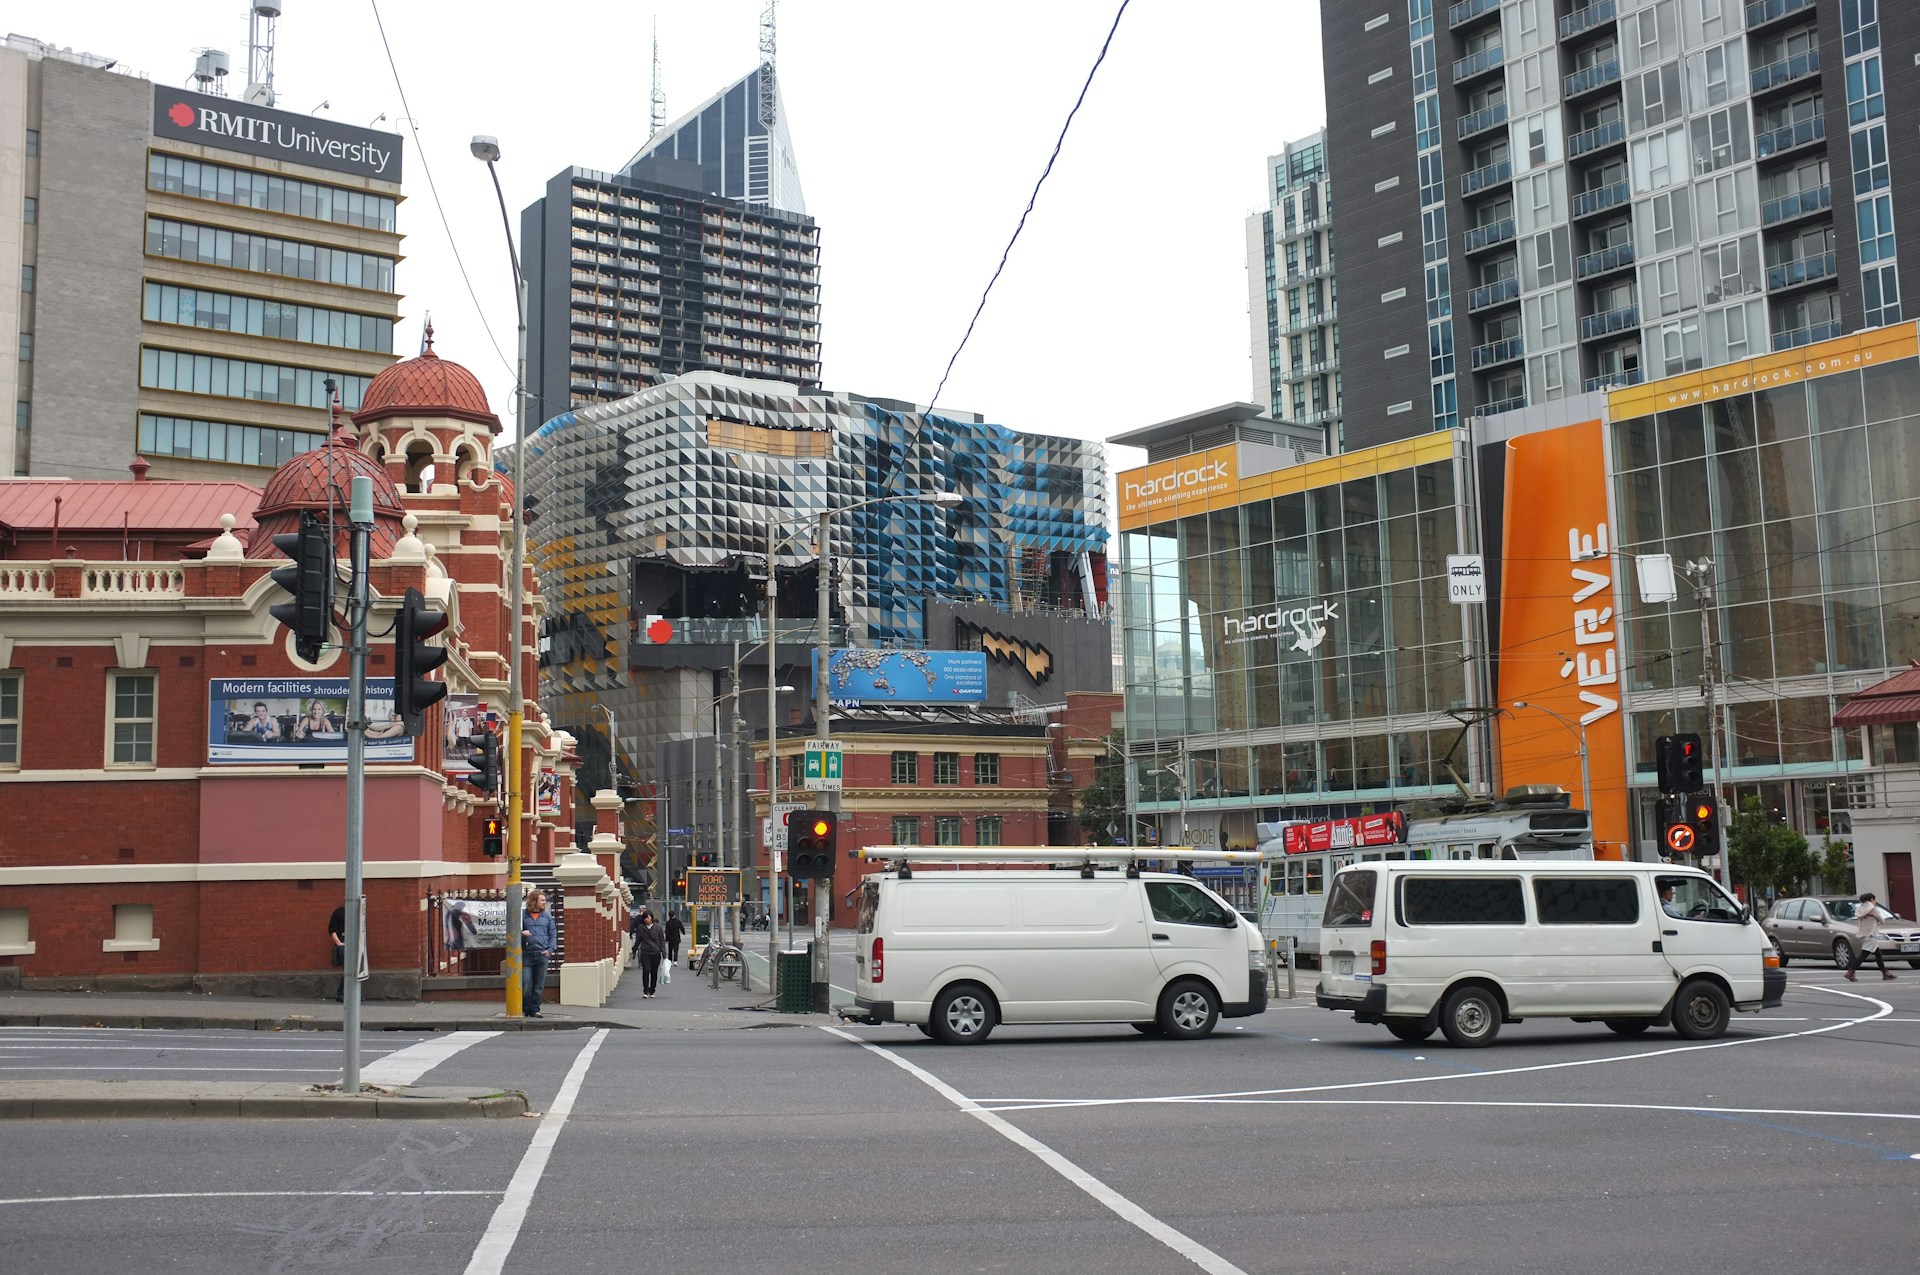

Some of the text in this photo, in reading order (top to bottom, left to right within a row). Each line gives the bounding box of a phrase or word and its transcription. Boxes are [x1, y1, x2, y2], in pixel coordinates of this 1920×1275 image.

[198, 107, 390, 173] RMIT University
[1669, 351, 1873, 404] www.hardrock.com.au
[1125, 460, 1228, 500] hardrock
[1138, 498, 1162, 508] ultimate
[1164, 491, 1191, 502] climbing
[1192, 482, 1228, 496] experience
[1452, 584, 1482, 596] ONLY
[1224, 600, 1339, 635] hardrock
[222, 682, 264, 693] Modern
[268, 681, 311, 693] facilities
[365, 686, 393, 697] history
[1331, 821, 1354, 848] Annie
[699, 885, 727, 893] WORKS
[702, 875, 724, 884] ROAD
[699, 894, 727, 902] AHEAD
[478, 909, 506, 917] Spinal
